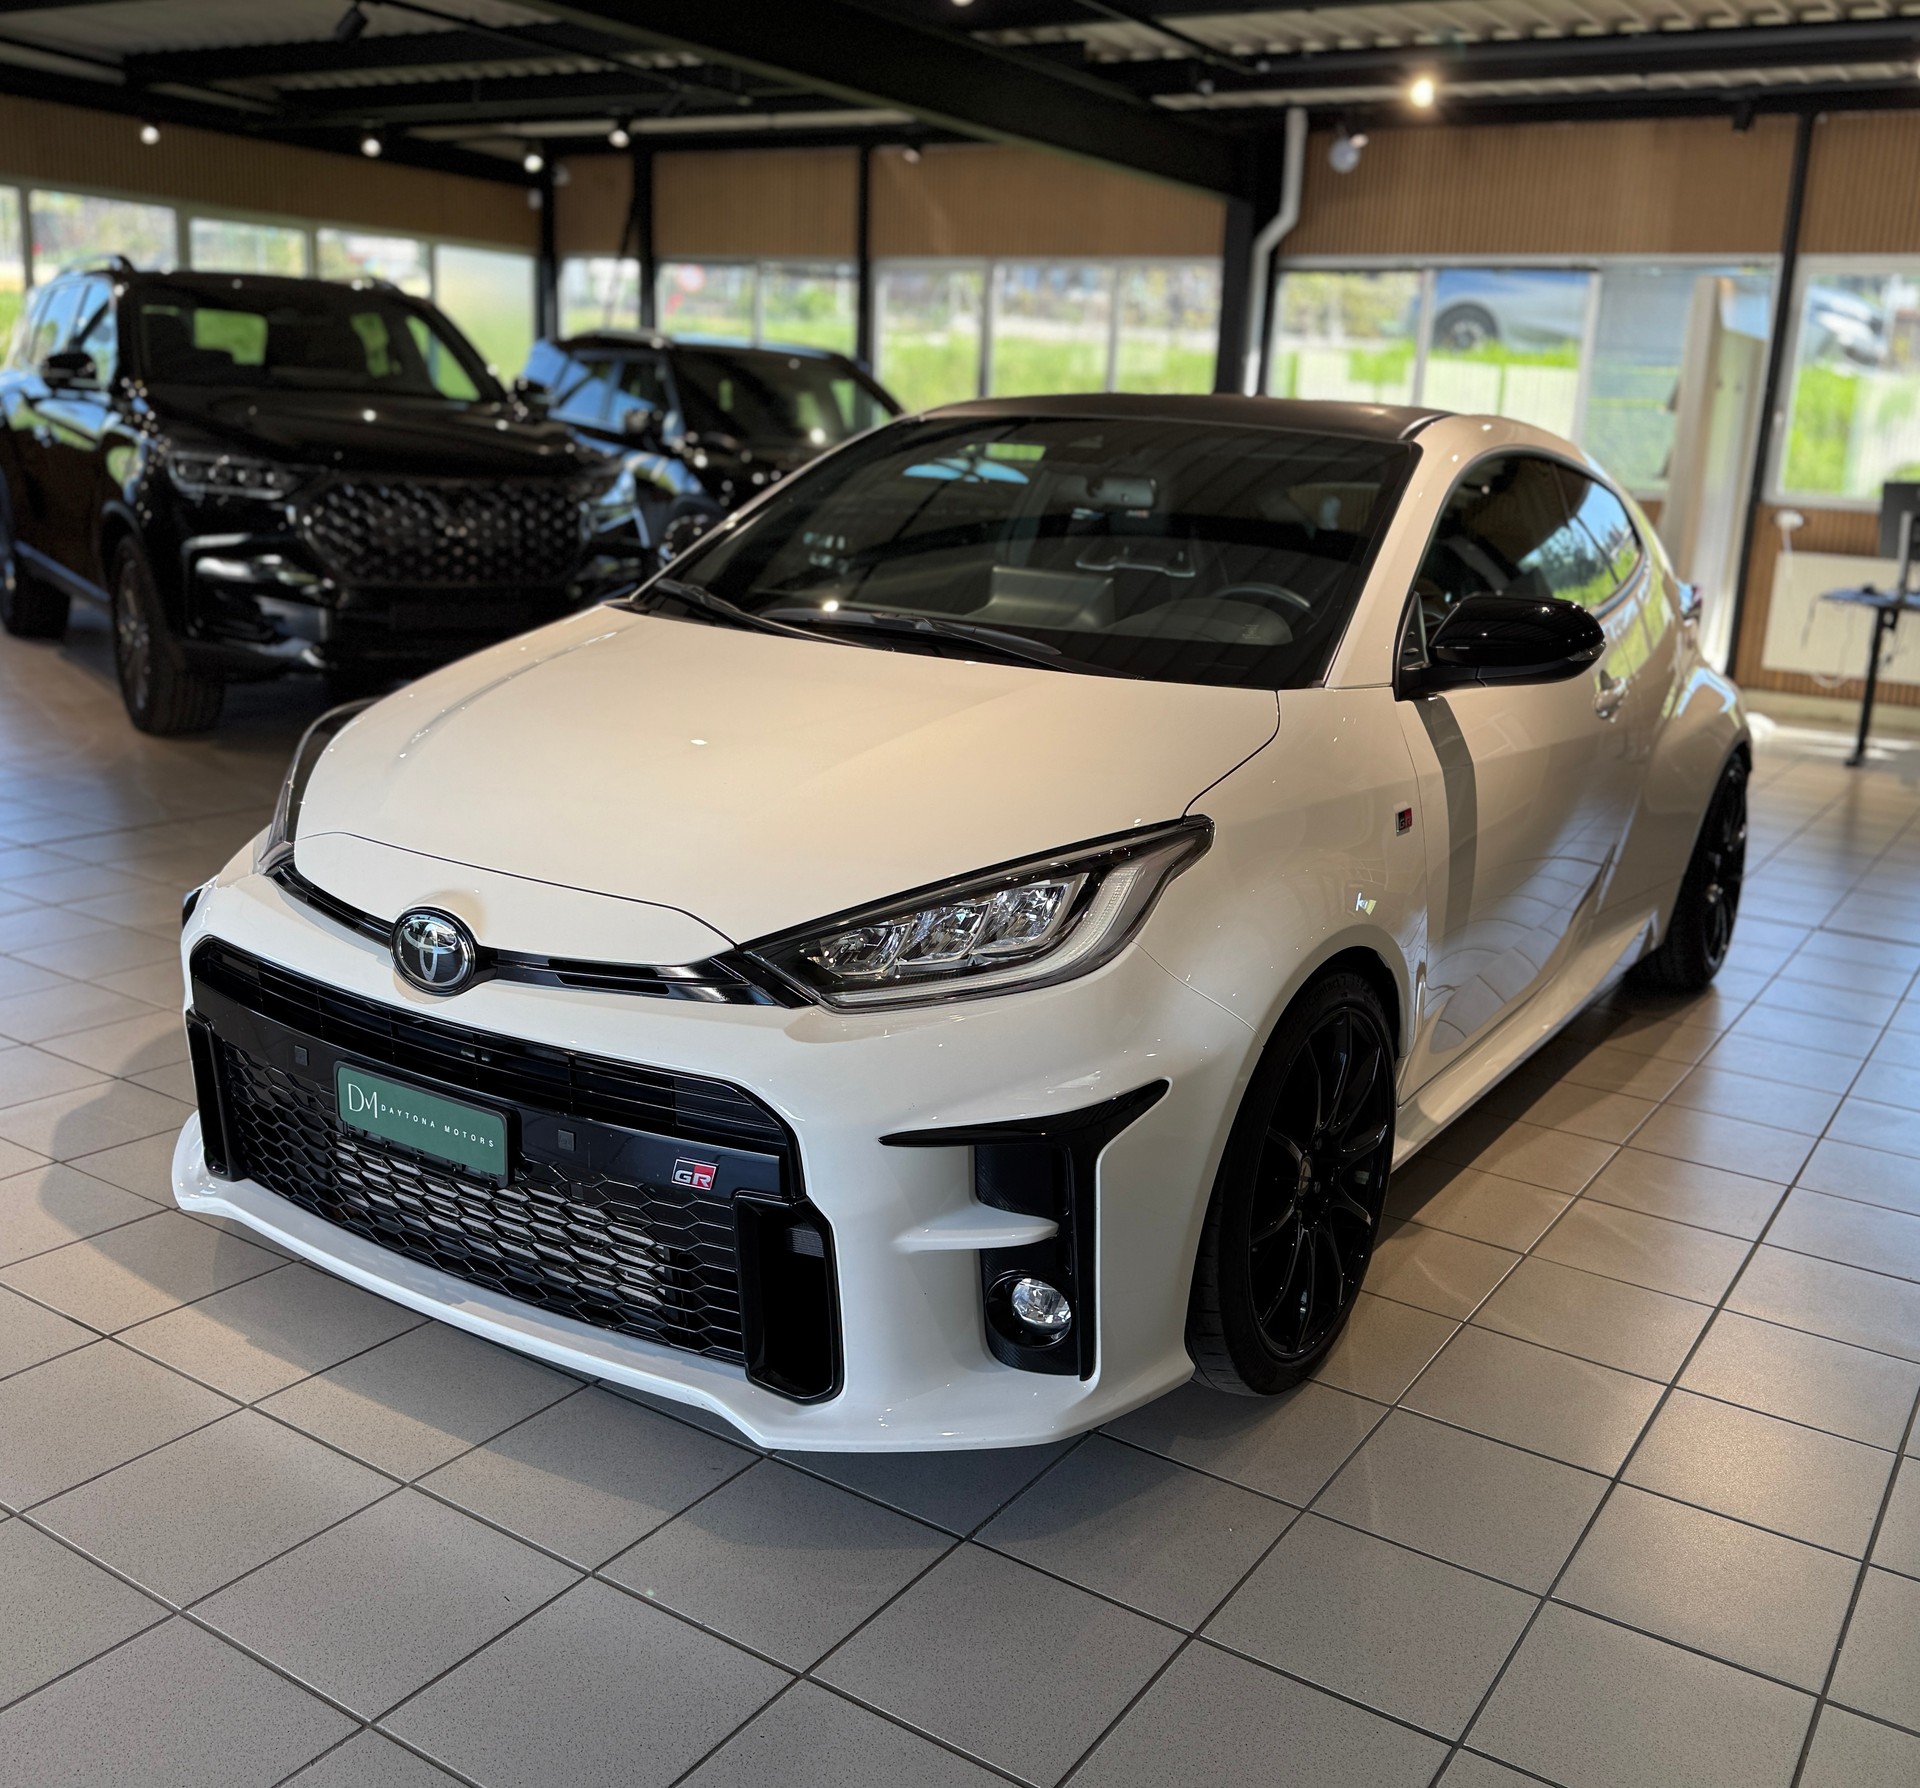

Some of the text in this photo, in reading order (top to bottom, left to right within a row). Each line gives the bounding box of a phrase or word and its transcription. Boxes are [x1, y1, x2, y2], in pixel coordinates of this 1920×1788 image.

[1400, 816, 1411, 828] GR
[347, 1083, 378, 1119] DM
[381, 1104, 494, 1148] DAYTONA MOTORS
[674, 1169, 711, 1187] GR
